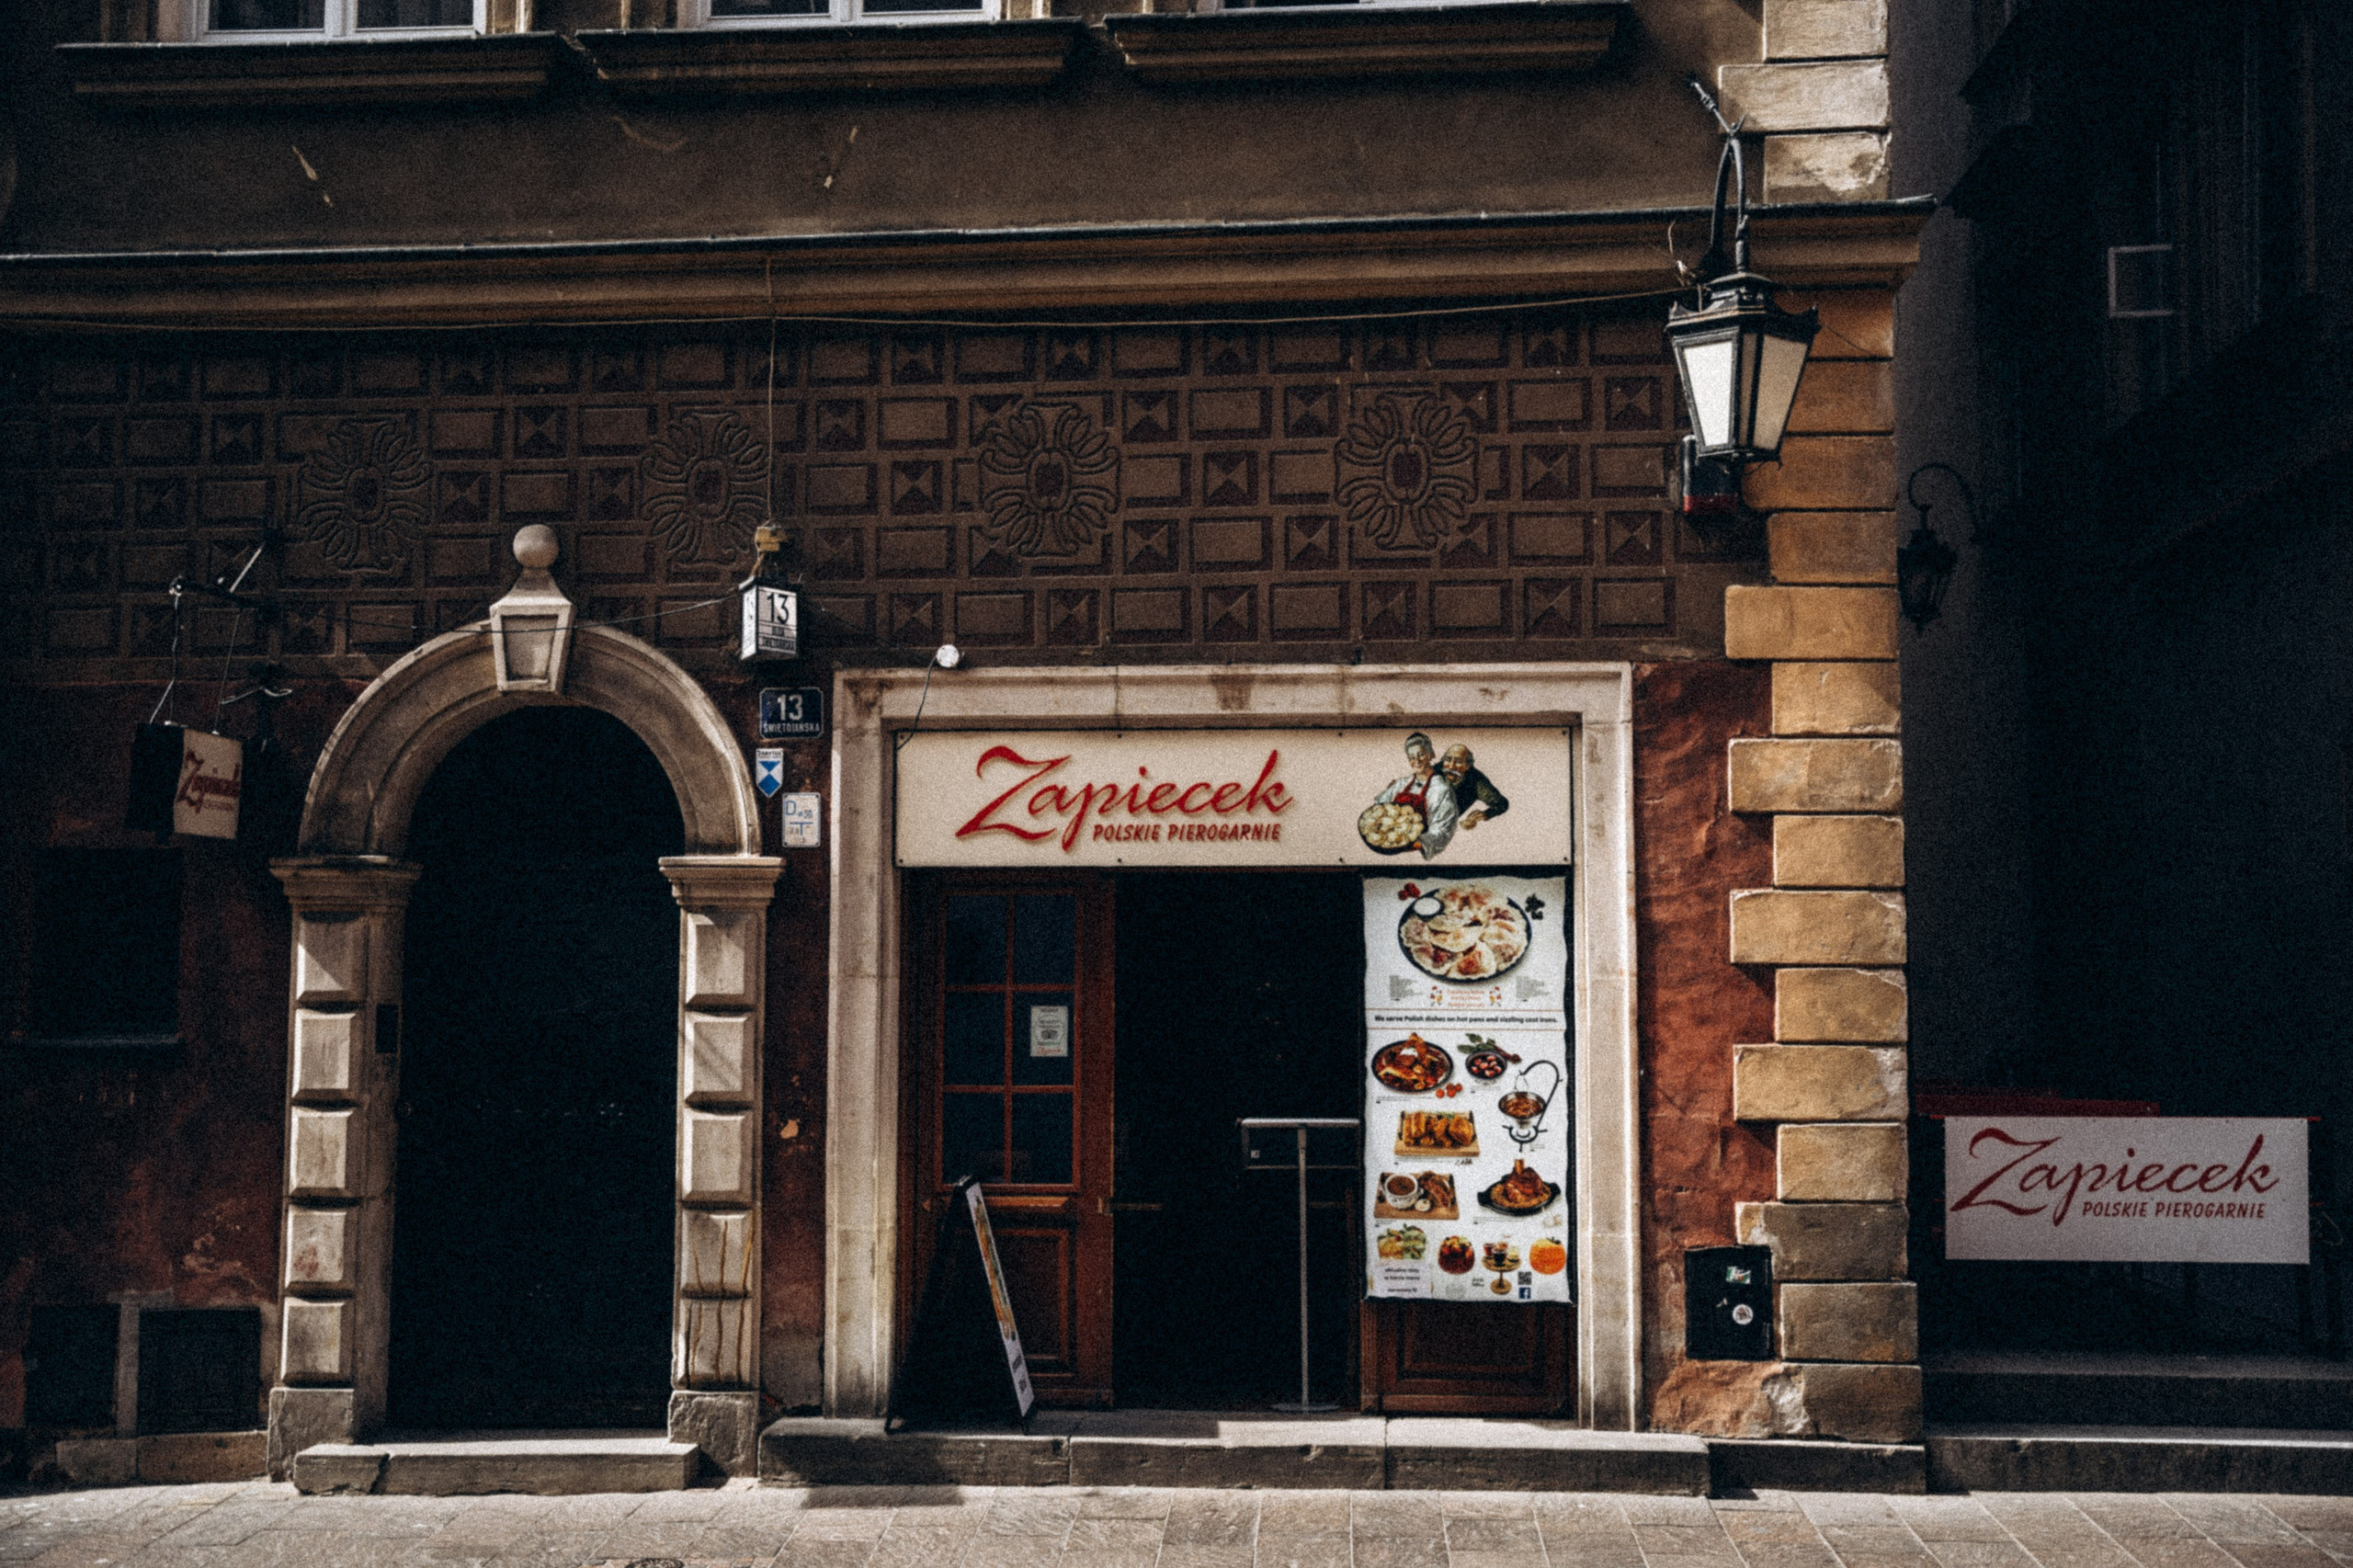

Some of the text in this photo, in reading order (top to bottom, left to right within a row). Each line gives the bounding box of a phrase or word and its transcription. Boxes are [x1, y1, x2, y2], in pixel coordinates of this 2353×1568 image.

[767, 592, 790, 624] 13
[778, 694, 803, 721] 13
[956, 745, 1293, 851] Zapiecek
[1092, 823, 1282, 842] POLSKIE PIEROGARNIE
[1949, 1128, 2280, 1226] Zapiecek
[2083, 1201, 2267, 1219] POLSKIE PIEROGARNIE
